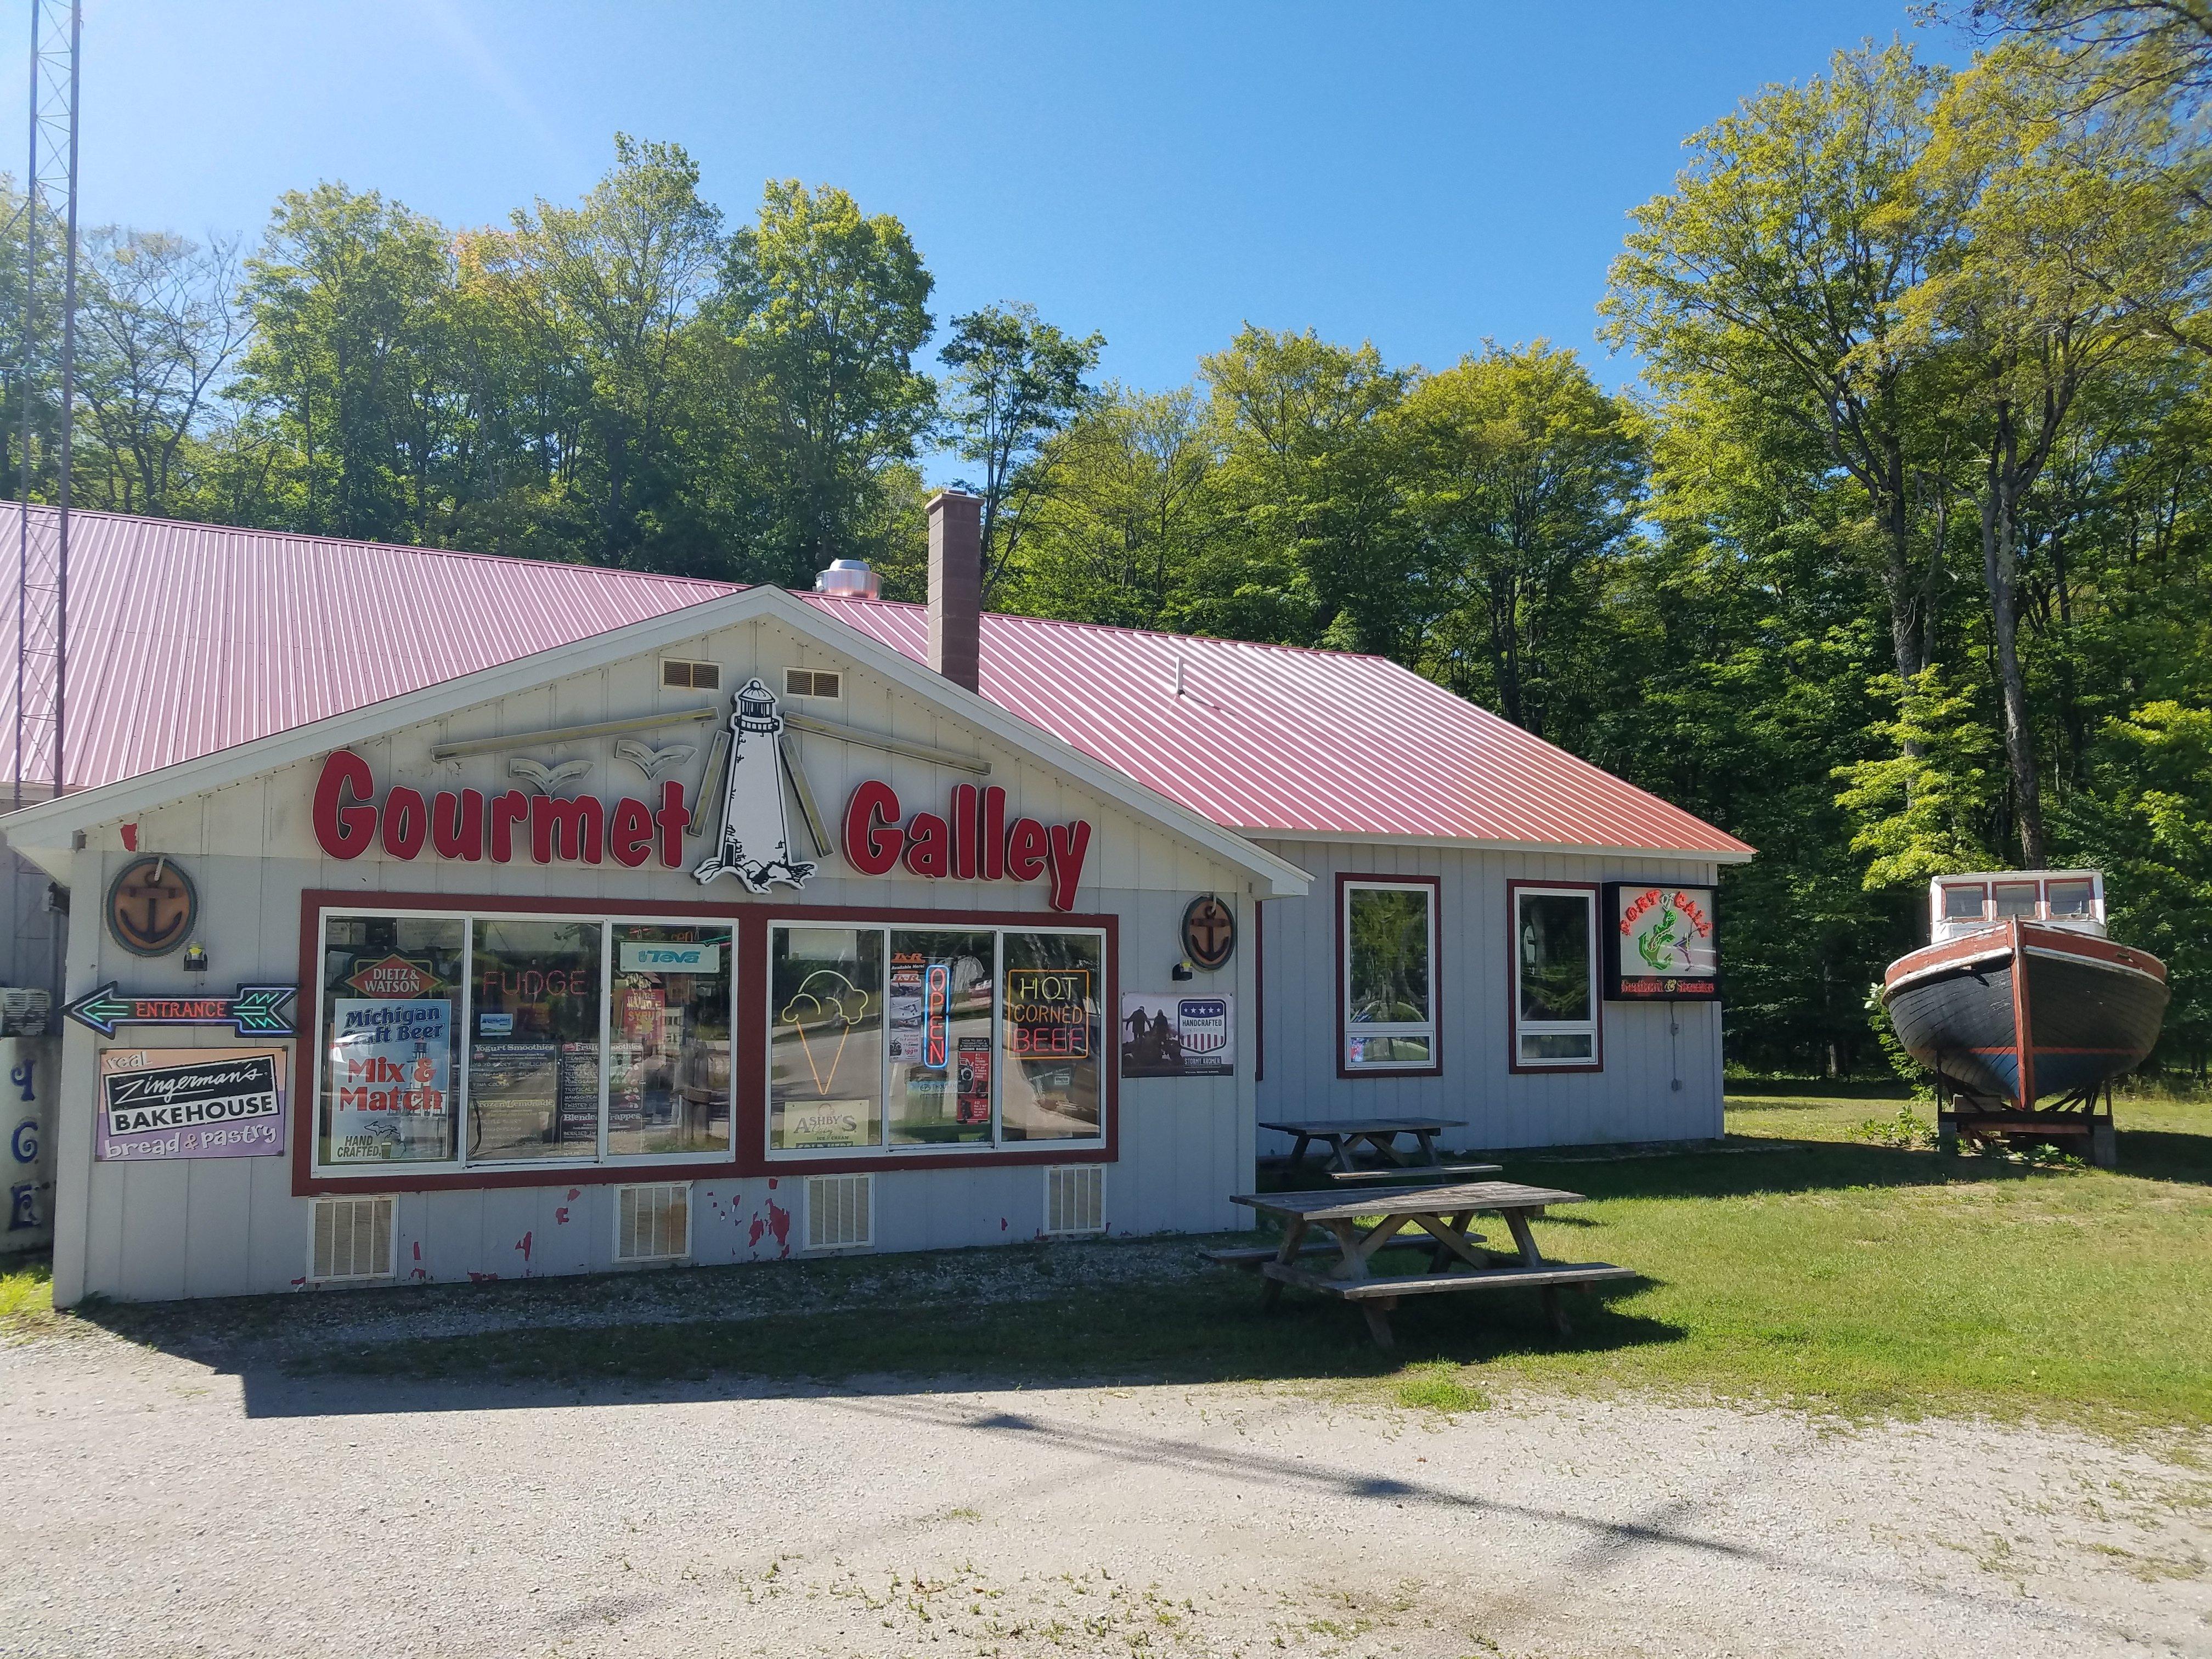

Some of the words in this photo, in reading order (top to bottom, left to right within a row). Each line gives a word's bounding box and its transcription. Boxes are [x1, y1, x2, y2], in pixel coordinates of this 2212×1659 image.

[312, 749, 690, 868] Gourmet
[842, 780, 1092, 912] Galley
[1620, 889, 1661, 936] PORT
[1674, 891, 1713, 938] CALL
[647, 950, 701, 963] Teva
[374, 969, 408, 980] DIETZ
[410, 969, 420, 980] &
[483, 970, 588, 996] FUDGE
[364, 980, 420, 993] WATSON
[1020, 977, 1078, 1000] HOT
[136, 1002, 227, 1018] ENTRANCE
[344, 1005, 442, 1029] Michigan
[930, 968, 945, 1064] OPEN
[1014, 1004, 1082, 1024] CORNED
[341, 1024, 392, 1045] Cft
[396, 1023, 445, 1042] Beer
[1013, 1028, 1086, 1052] BEEF
[576, 1042, 597, 1051] Fruit
[106, 1051, 154, 1069] real
[348, 1056, 405, 1083] Mix
[414, 1058, 436, 1082] &
[114, 1063, 263, 1104] Zingerman's
[340, 1086, 442, 1111] Match
[507, 1099, 554, 1108] Lemonade
[115, 1095, 273, 1131] BAKEHOUSE
[609, 1113, 641, 1121] rappes
[793, 1114, 857, 1133] ASHBY'S
[104, 1132, 182, 1158] bread
[185, 1133, 199, 1150] &
[201, 1124, 276, 1149] pastry
[345, 1136, 373, 1146] HAND
